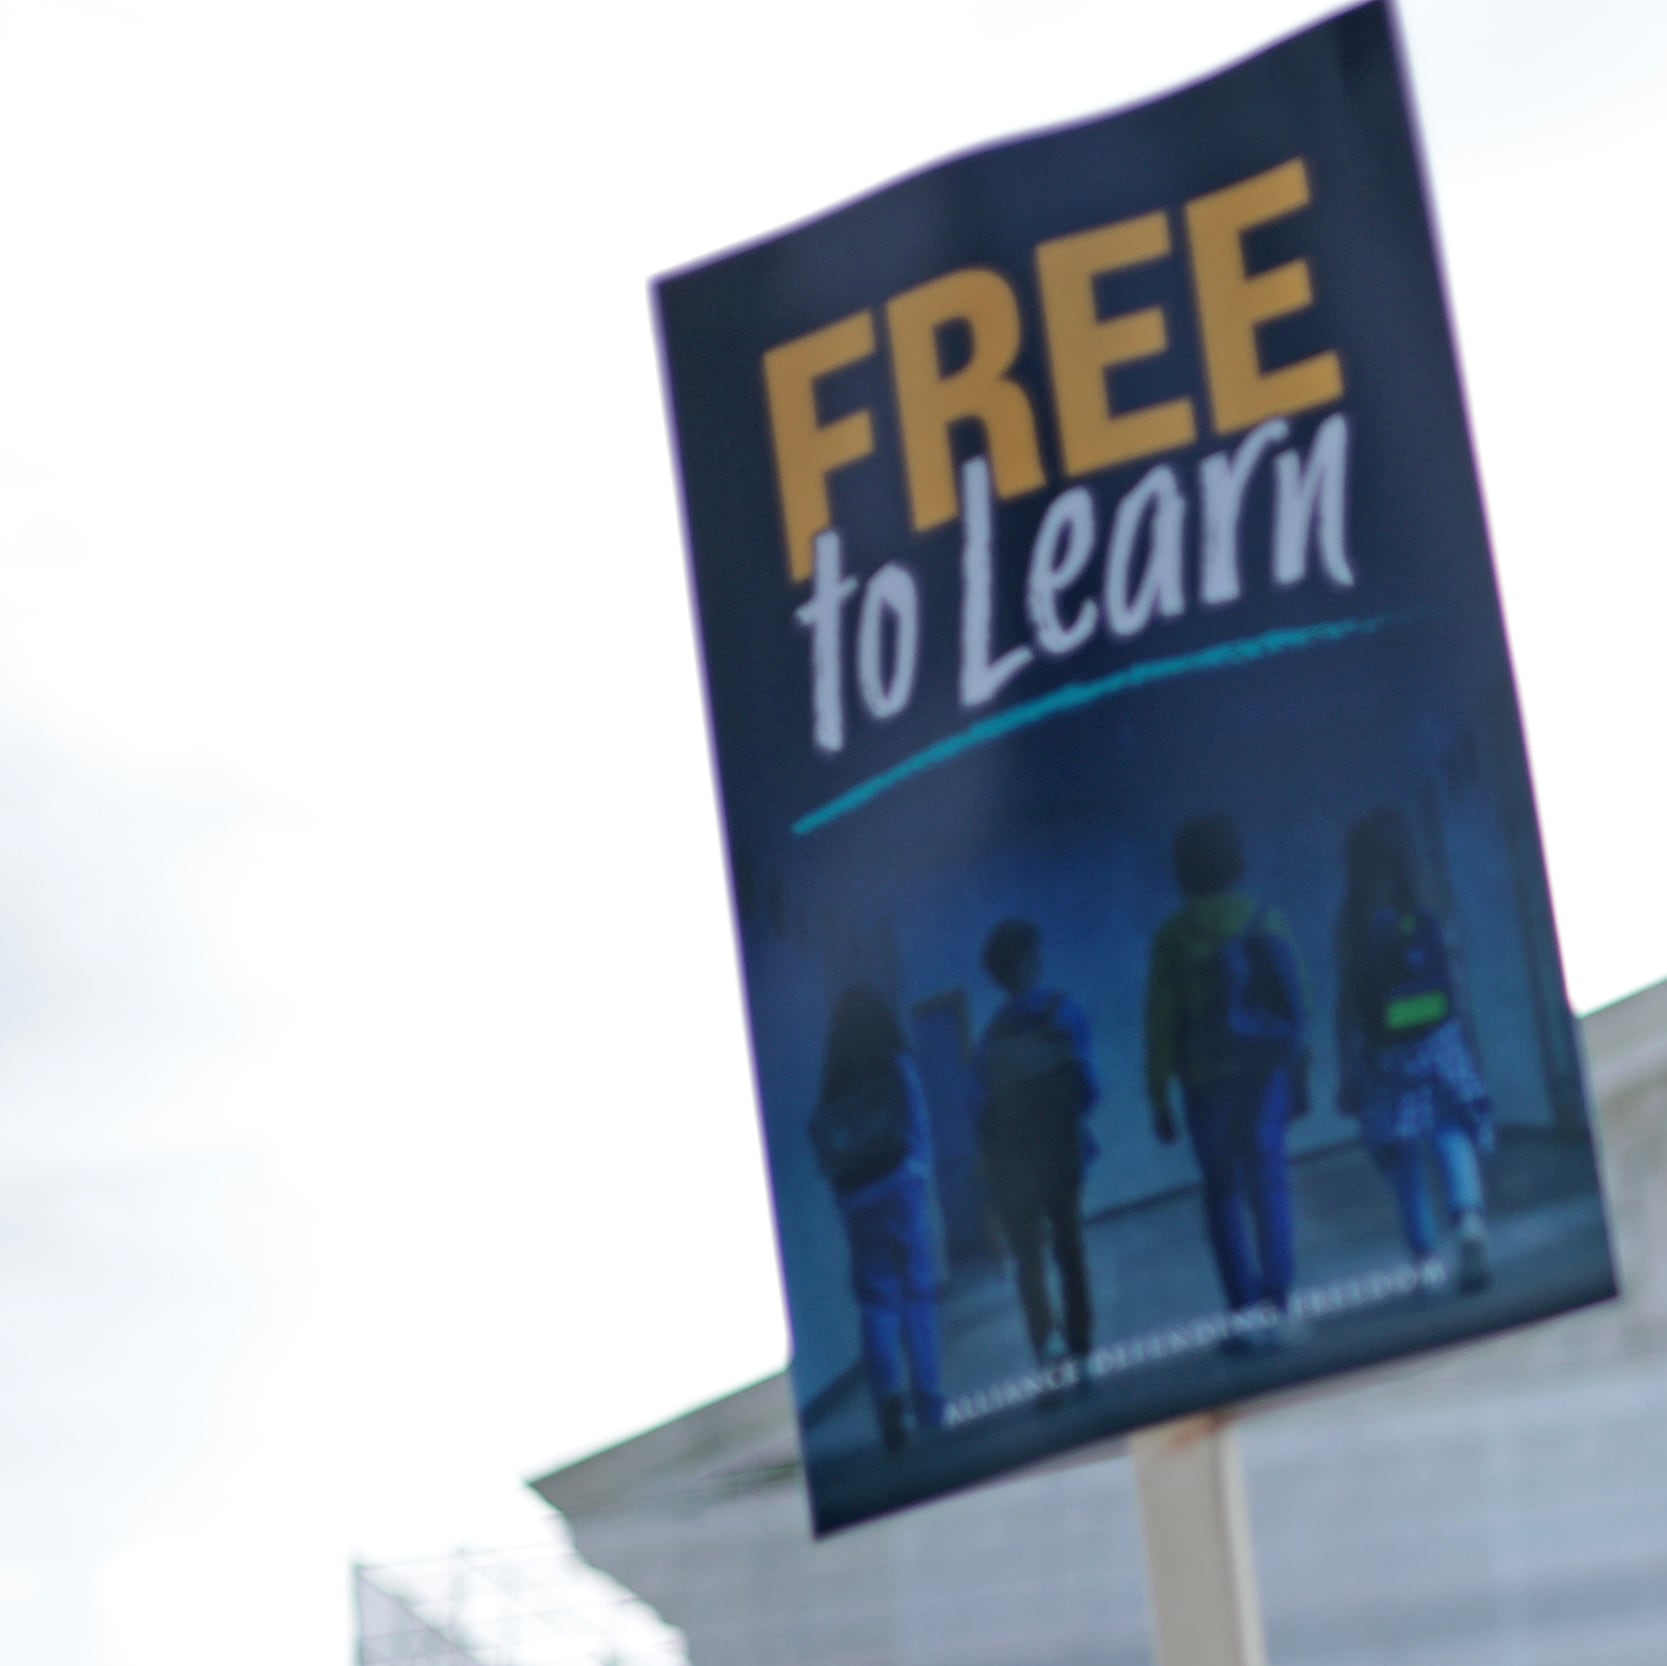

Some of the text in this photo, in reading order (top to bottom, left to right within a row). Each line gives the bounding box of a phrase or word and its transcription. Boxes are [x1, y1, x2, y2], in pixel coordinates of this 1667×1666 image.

[763, 157, 1344, 583] FREE
[795, 412, 1354, 751] to Learn
